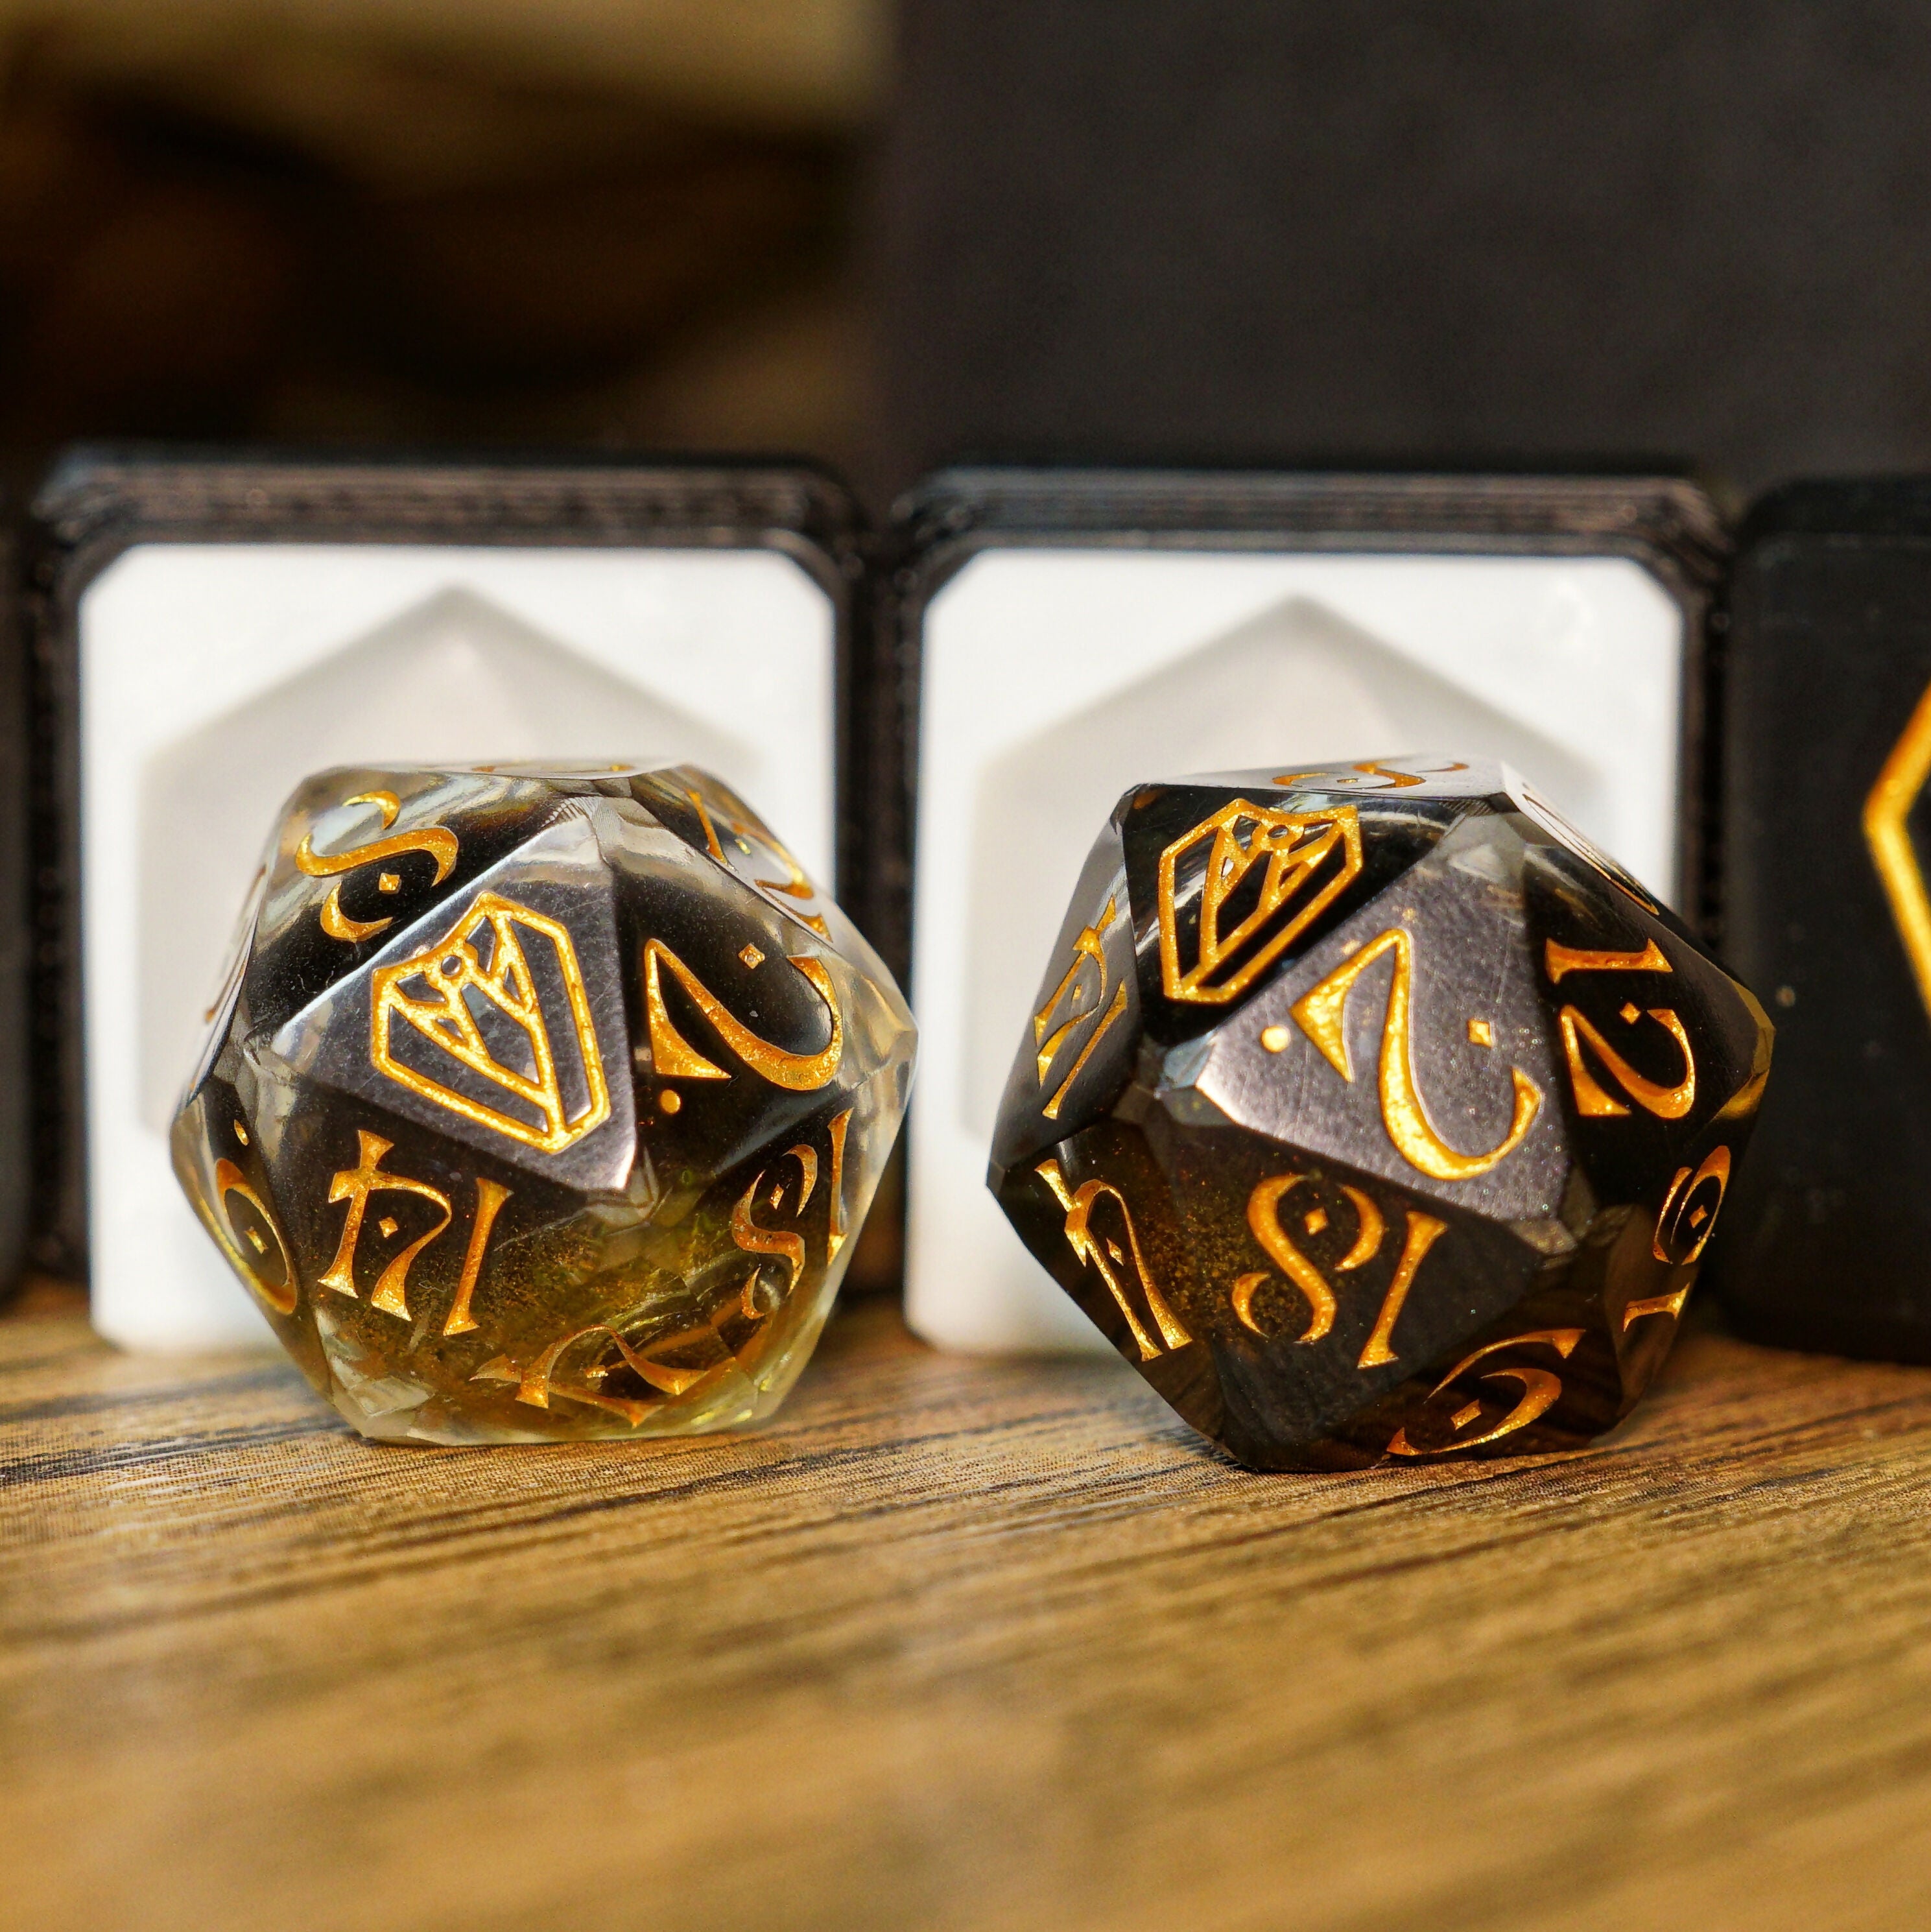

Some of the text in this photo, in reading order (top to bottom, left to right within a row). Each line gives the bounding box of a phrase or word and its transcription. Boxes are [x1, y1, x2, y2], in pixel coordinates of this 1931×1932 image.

[296, 791, 457, 940] 8
[645, 938, 843, 1091] 2
[1288, 928, 1545, 1179] 2
[1546, 938, 1695, 1119] 12
[1233, 1175, 1447, 1370] 18
